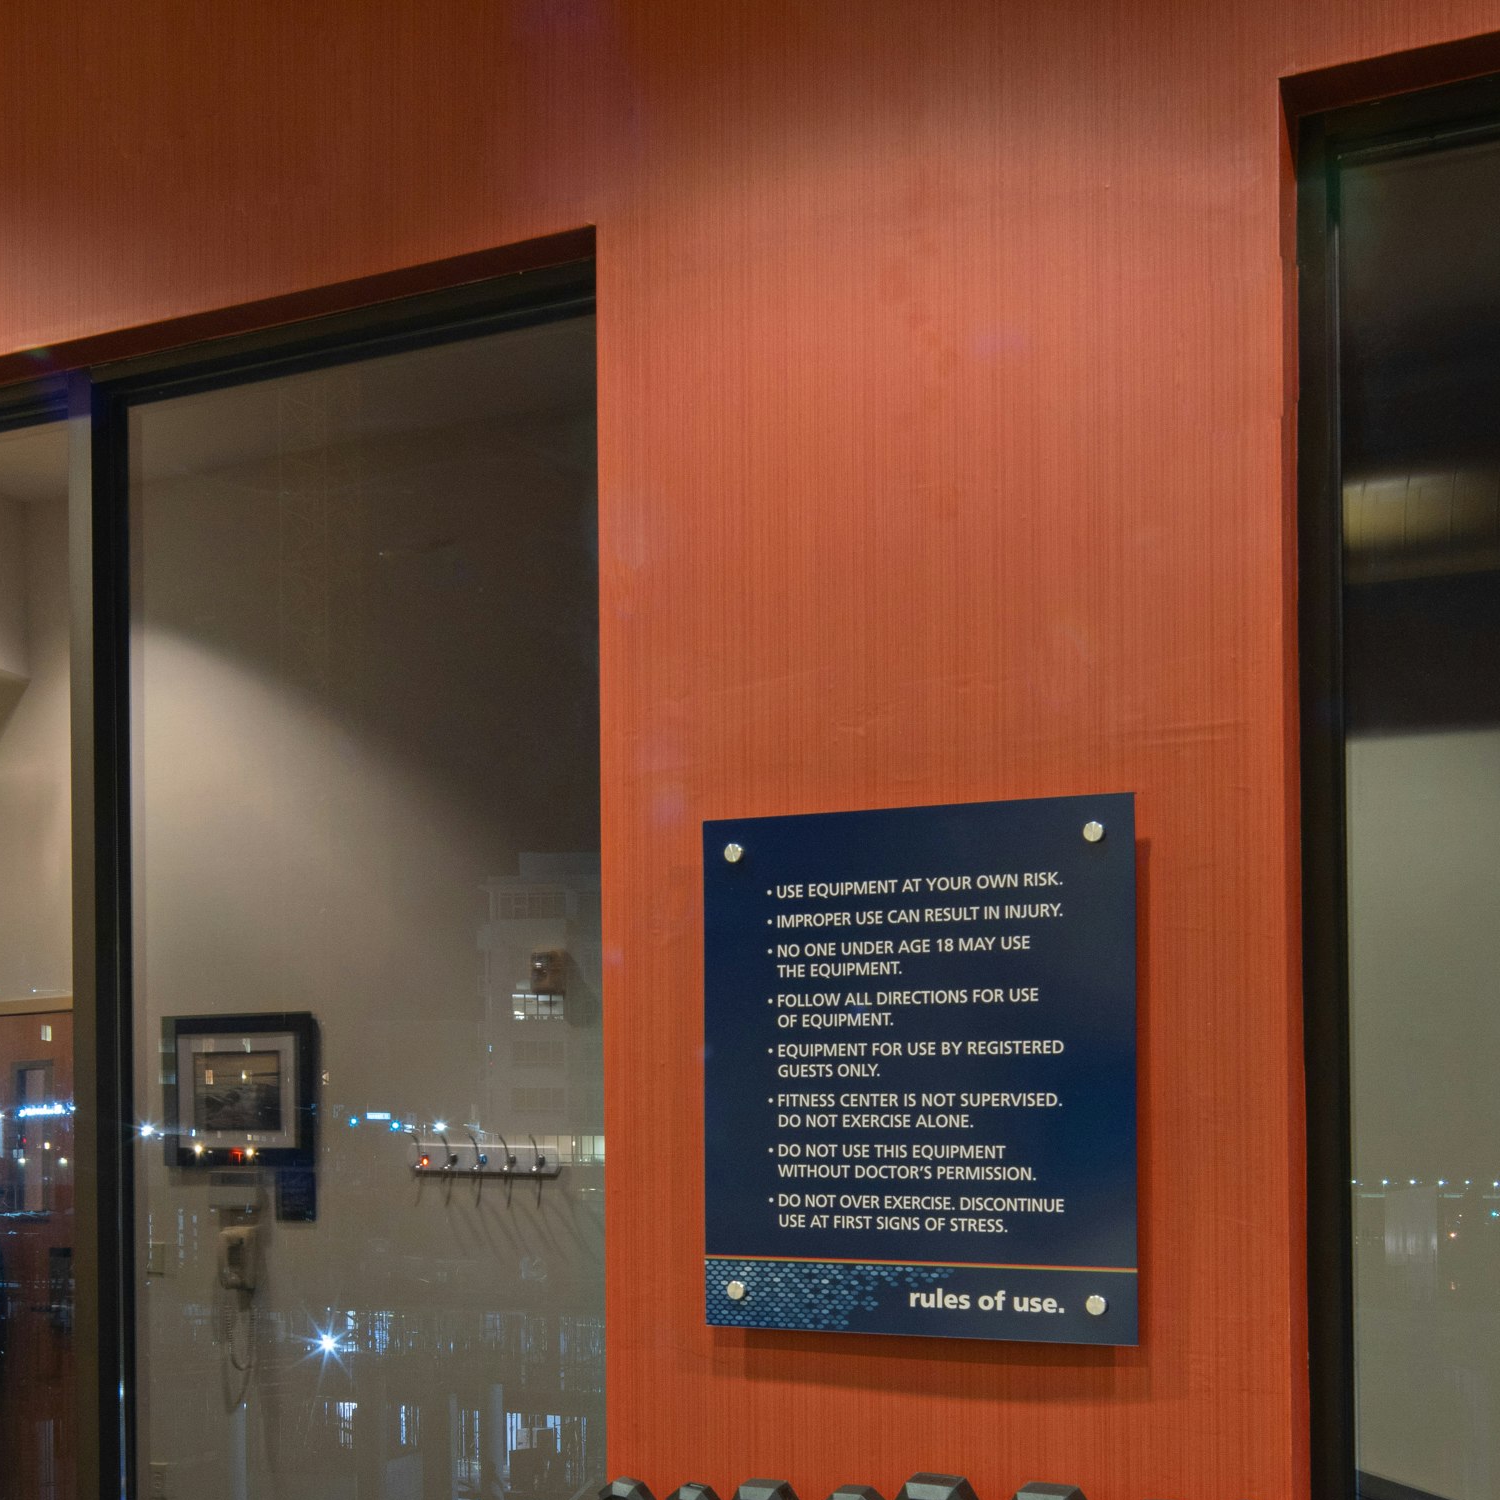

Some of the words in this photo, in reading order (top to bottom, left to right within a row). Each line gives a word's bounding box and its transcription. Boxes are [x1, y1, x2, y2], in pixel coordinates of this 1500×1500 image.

[776, 884, 804, 899] USE
[808, 879, 898, 899] EQUIPMENT
[901, 878, 923, 893] AT
[925, 875, 972, 892] YOUR
[976, 873, 1019, 890] OWN
[1023, 871, 1064, 887] RISK.
[777, 911, 852, 929] IMPROPER
[855, 910, 883, 925] USE
[887, 908, 920, 924] CAN
[924, 906, 980, 923] RESULT
[983, 905, 1000, 920] IN
[1004, 902, 1064, 919] INJURY.
[777, 943, 801, 958] NO
[804, 942, 837, 957] ONE
[841, 940, 894, 956] UNDER
[897, 938, 931, 954] AGE
[936, 938, 954, 953] 18
[958, 936, 996, 952] MAY
[1000, 935, 1031, 951] USE
[776, 963, 806, 978] THE
[810, 960, 903, 979] EQUIPMENT.
[777, 992, 841, 1008] FOLLOW
[844, 992, 873, 1006] ALL
[876, 989, 968, 1006] DIRECTIONS
[972, 988, 1005, 1003] FOR
[1009, 987, 1039, 1003] USE
[777, 1014, 798, 1028] OF
[802, 1012, 894, 1030] EQUIPMENT.
[777, 1042, 868, 1060] EQUIPMENT
[872, 1042, 903, 1057] FOR
[907, 1041, 936, 1056] USE
[941, 1041, 963, 1056] BY
[967, 1039, 1065, 1055] REGISTERED
[777, 1063, 834, 1078] GUESTS
[837, 1063, 881, 1078] ONLY.
[777, 1093, 836, 1108] FITNESS
[839, 1093, 899, 1108] CENTER
[903, 1093, 917, 1108] IS
[921, 1093, 957, 1107] NOT
[960, 1092, 1063, 1107] SUPERVISED.
[778, 1113, 802, 1128] DO
[805, 1114, 839, 1128] NOT
[842, 1114, 911, 1128] EXERCISE
[915, 1113, 974, 1129] ALONE.
[778, 1143, 802, 1158] DO
[805, 1143, 839, 1158] NOT
[842, 1144, 870, 1158] USE
[873, 1144, 908, 1159] THIS
[912, 1144, 1007, 1161] EQUIPMENT
[777, 1164, 851, 1179] WITHOUT
[854, 1164, 933, 1180] DOCTOR'S
[936, 1165, 1037, 1181] PERMISSION.
[778, 1193, 801, 1208] DO
[804, 1194, 837, 1208] NOT
[839, 1194, 880, 1209] OVER
[884, 1195, 956, 1211] EXERCISE.
[959, 1196, 1065, 1213] DISCONTINUE
[778, 1213, 806, 1228] USE
[809, 1214, 830, 1229] AT
[833, 1215, 873, 1230] FIRST
[876, 1215, 921, 1231] SIGNS
[924, 1217, 946, 1232] OF
[949, 1217, 1008, 1233] STRESS.
[909, 1288, 971, 1310] rules
[977, 1290, 1006, 1311] of
[1013, 1296, 1065, 1314] use.
